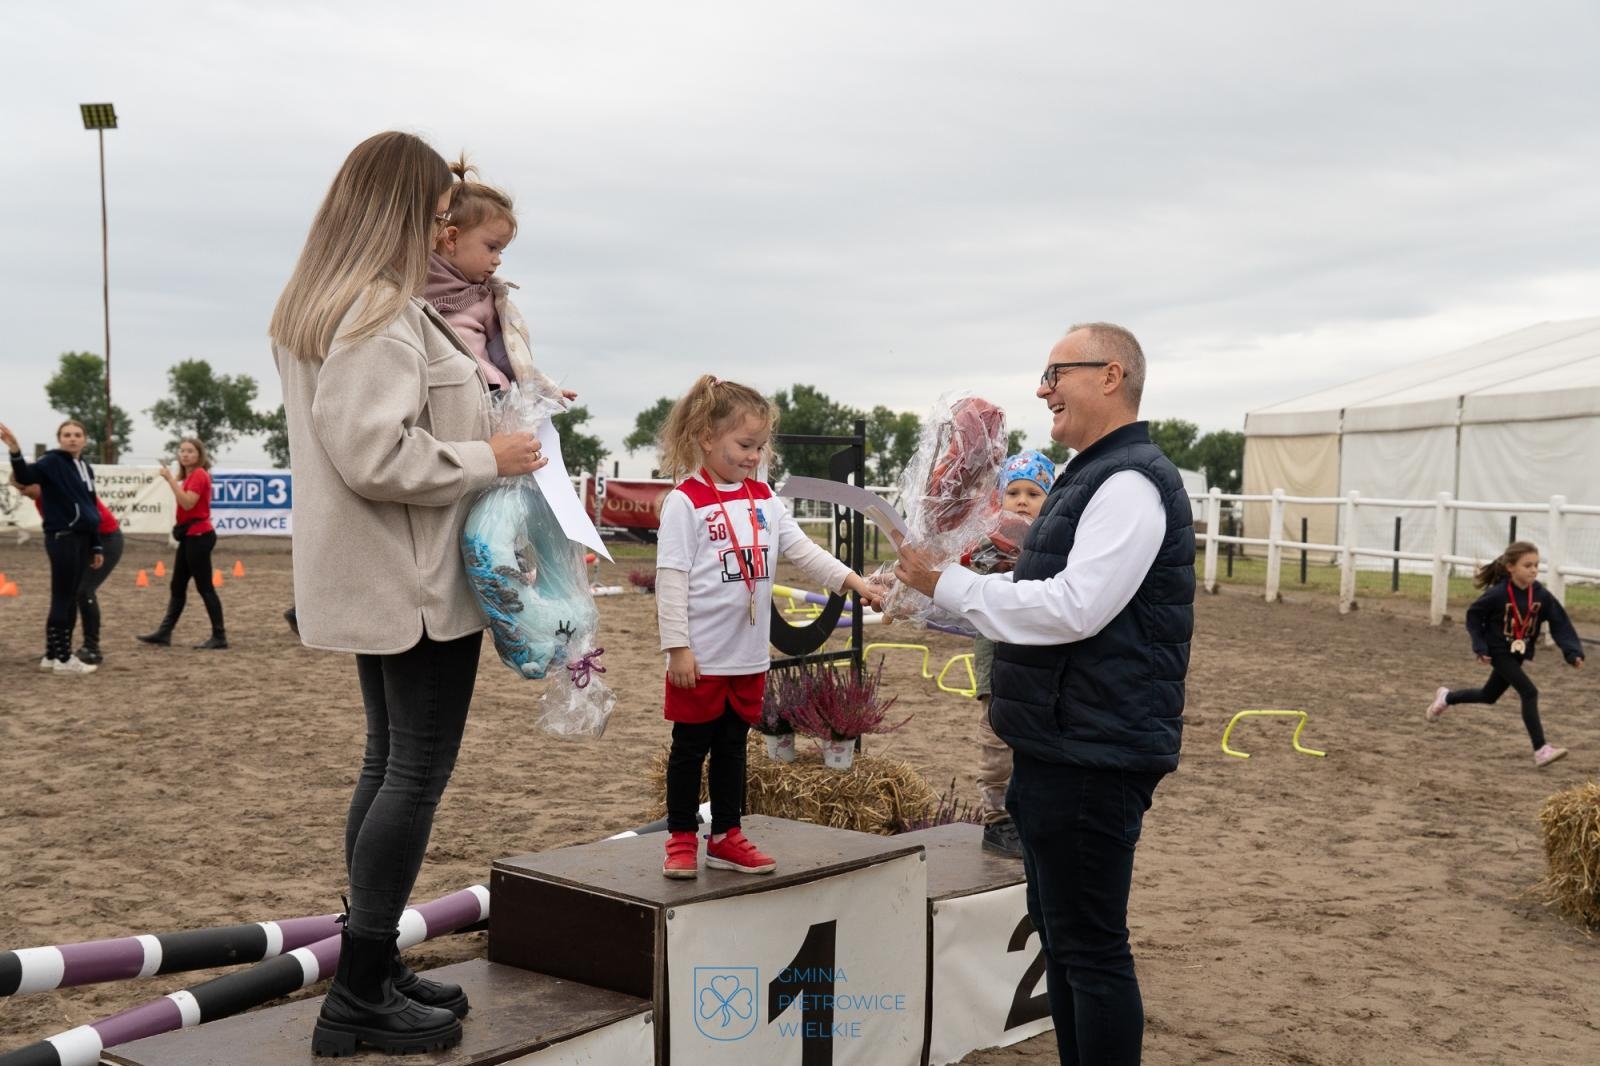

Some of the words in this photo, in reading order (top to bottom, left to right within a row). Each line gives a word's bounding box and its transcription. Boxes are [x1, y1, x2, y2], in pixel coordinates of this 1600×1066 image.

[95, 473, 153, 486] zyszenie
[597, 476, 605, 496] 5
[98, 487, 137, 499] wców
[212, 482, 259, 500] TVP
[267, 479, 287, 504] 3
[210, 516, 287, 529] ATOWICE
[708, 522, 727, 542] 58
[1003, 912, 1052, 1032] 2
[767, 918, 837, 1066] 1
